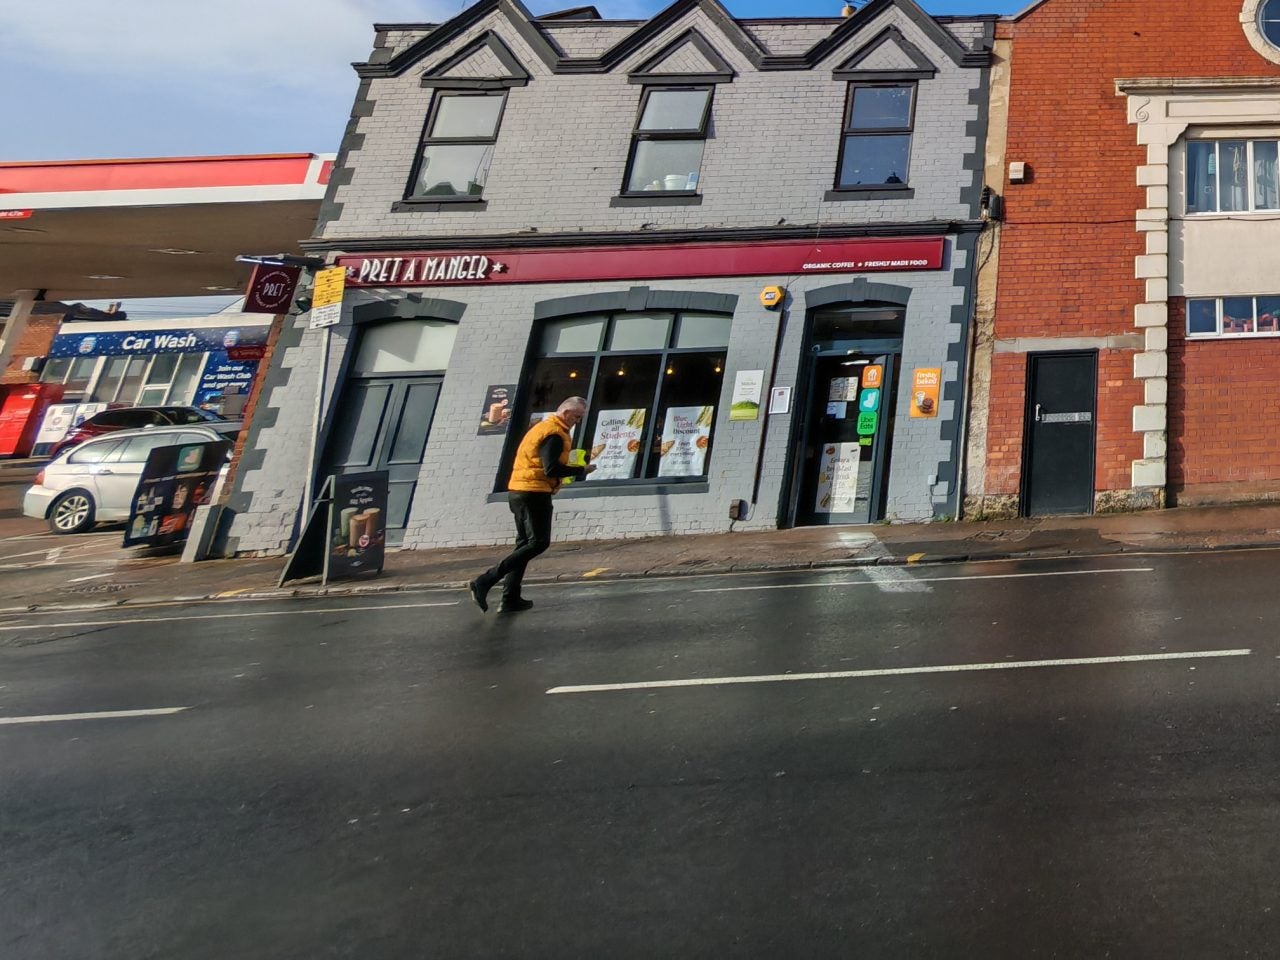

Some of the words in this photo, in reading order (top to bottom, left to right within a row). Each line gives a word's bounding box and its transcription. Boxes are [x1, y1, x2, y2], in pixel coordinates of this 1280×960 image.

[358, 258, 403, 282] PRET
[404, 258, 416, 281] A
[422, 255, 489, 280] MANGER
[263, 282, 286, 297] PRET
[122, 336, 149, 350] Car
[154, 333, 197, 349] Wash
[601, 419, 626, 427] Calling
[860, 422, 874, 430] Eats
[600, 431, 636, 440] Students
